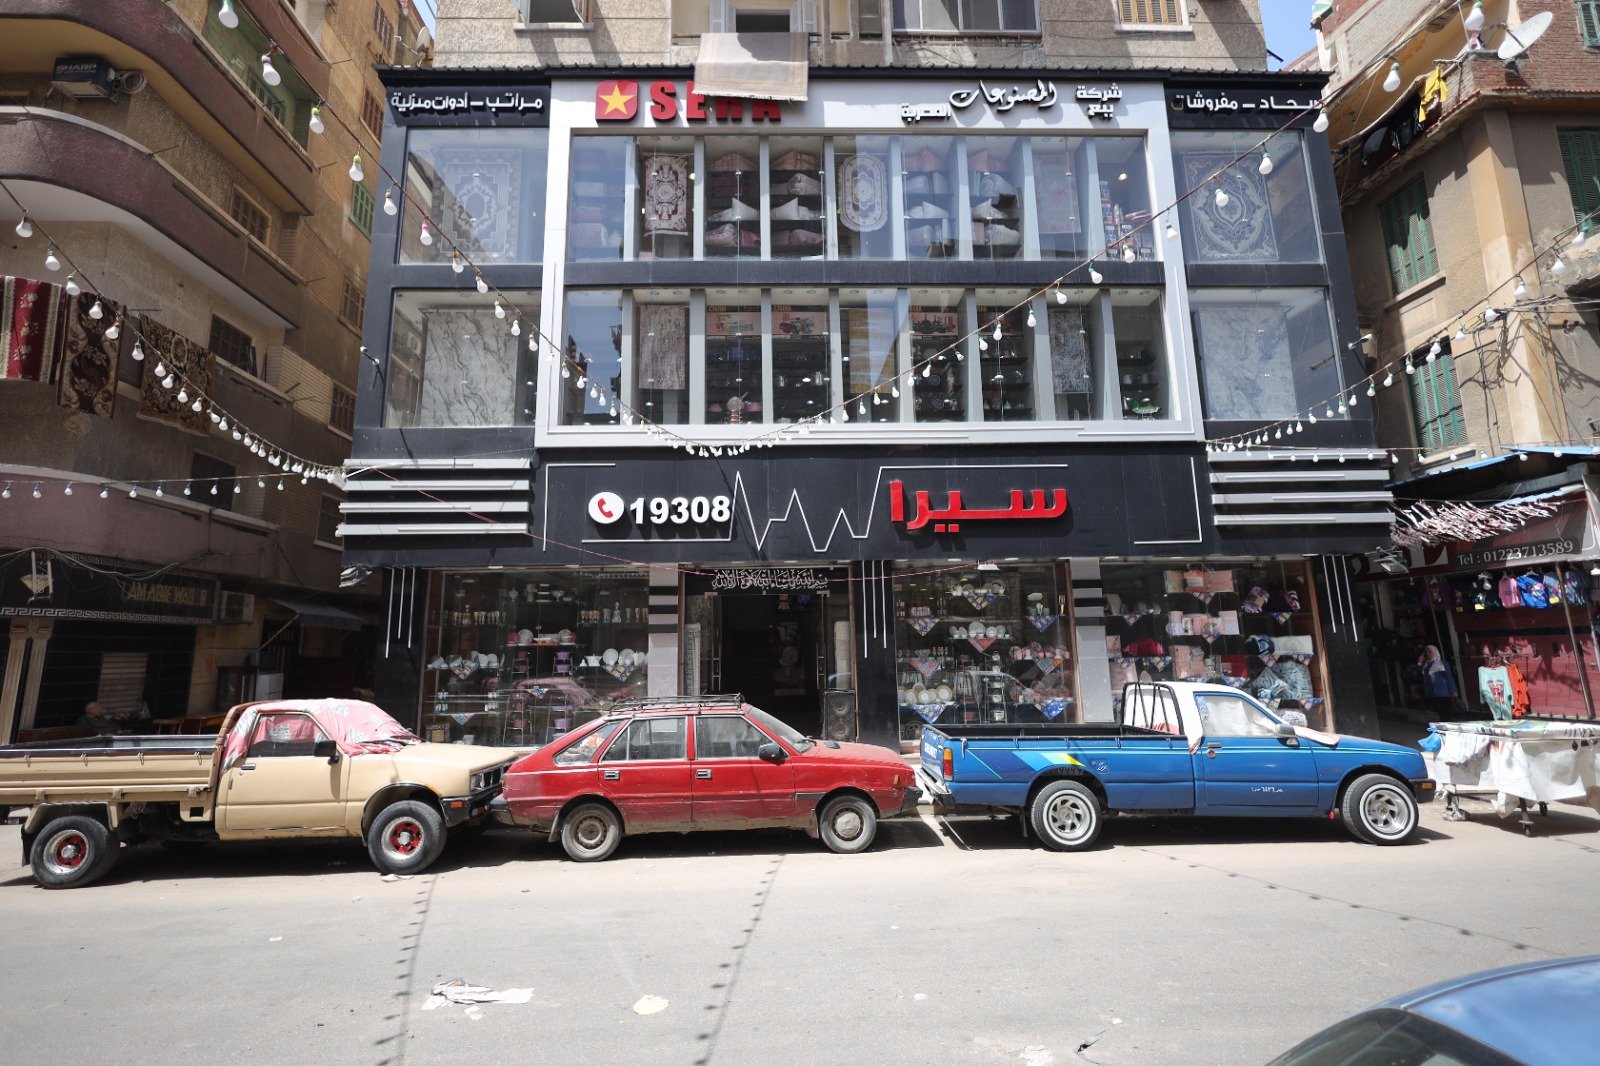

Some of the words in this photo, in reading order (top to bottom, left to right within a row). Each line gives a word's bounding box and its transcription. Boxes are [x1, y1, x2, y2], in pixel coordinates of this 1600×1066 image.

[56, 63, 97, 71] SHARP
[432, 92, 468, 110] أدوات
[949, 79, 1058, 112] المصنوعات
[1075, 82, 1123, 101] شركة
[1171, 91, 1239, 111] مفروشات
[486, 92, 543, 112] مراتب
[901, 102, 951, 122] المصرية
[1087, 101, 1114, 120] بيع
[629, 495, 731, 526] 19308
[889, 479, 1069, 533] سيرا
[1457, 553, 1474, 566] Tel
[1484, 541, 1573, 563] 01223713589
